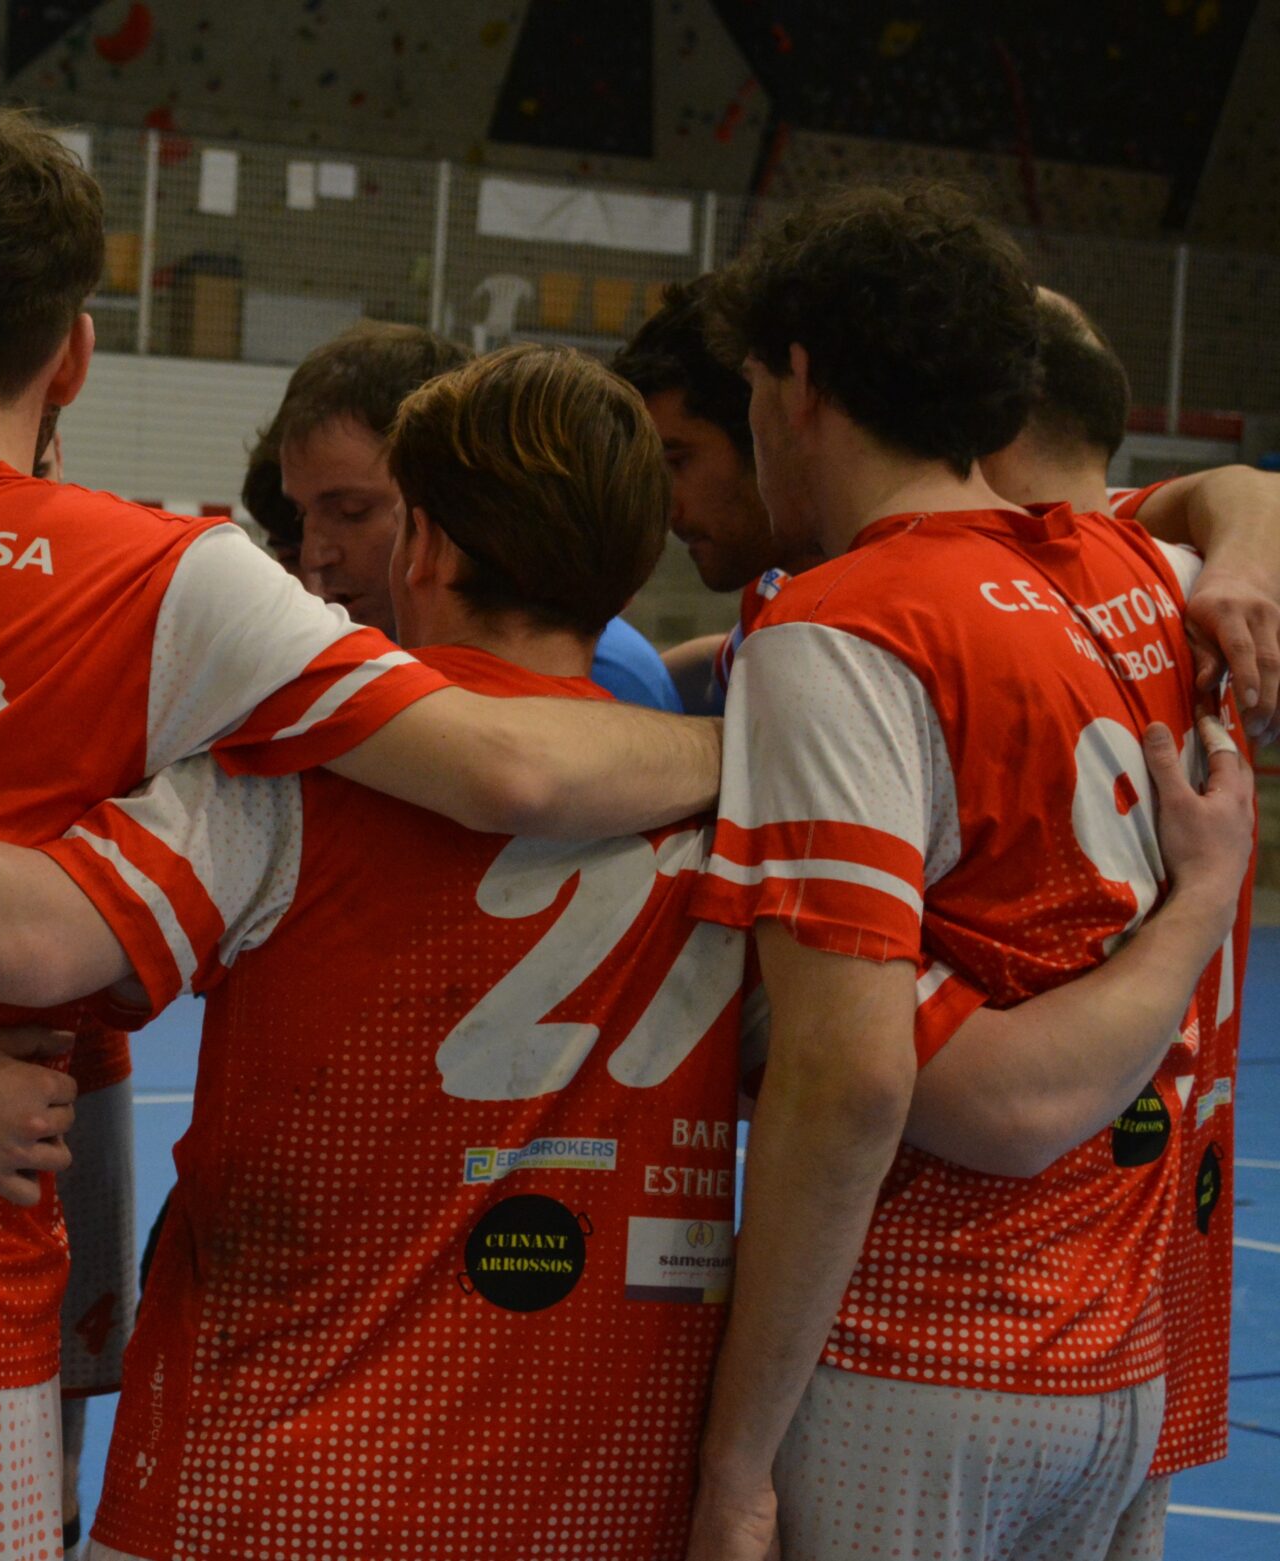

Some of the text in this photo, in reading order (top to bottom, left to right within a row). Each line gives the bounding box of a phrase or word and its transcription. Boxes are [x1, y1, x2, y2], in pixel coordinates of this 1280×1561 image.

[980, 580, 1058, 614] C.E.
[672, 1118, 730, 1149] BAR
[644, 1165, 733, 1197] ESTHE
[485, 1233, 568, 1249] CUINANT
[477, 1257, 574, 1273] ARROSSOS
